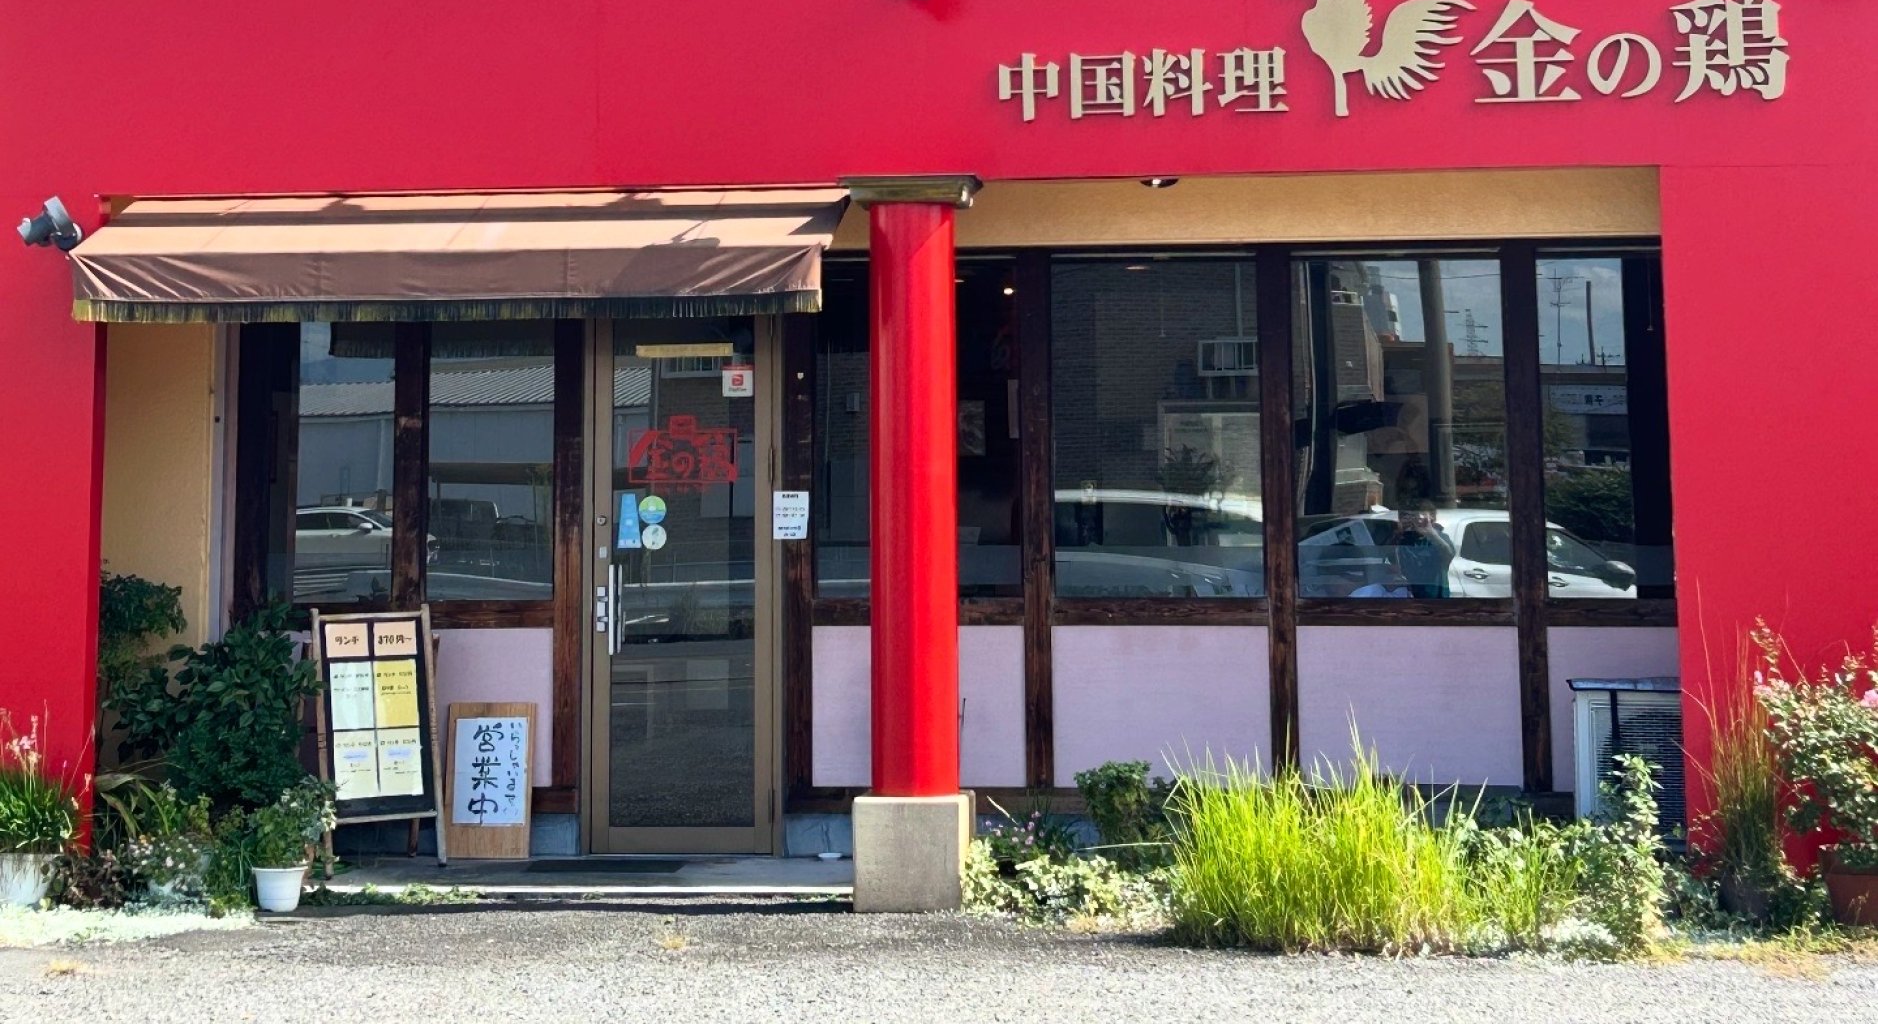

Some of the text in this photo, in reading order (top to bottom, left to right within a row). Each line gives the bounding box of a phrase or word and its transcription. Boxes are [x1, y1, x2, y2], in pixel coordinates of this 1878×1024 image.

[999, 46, 1289, 122] 中国料理
[468, 722, 505, 824] 営業中
